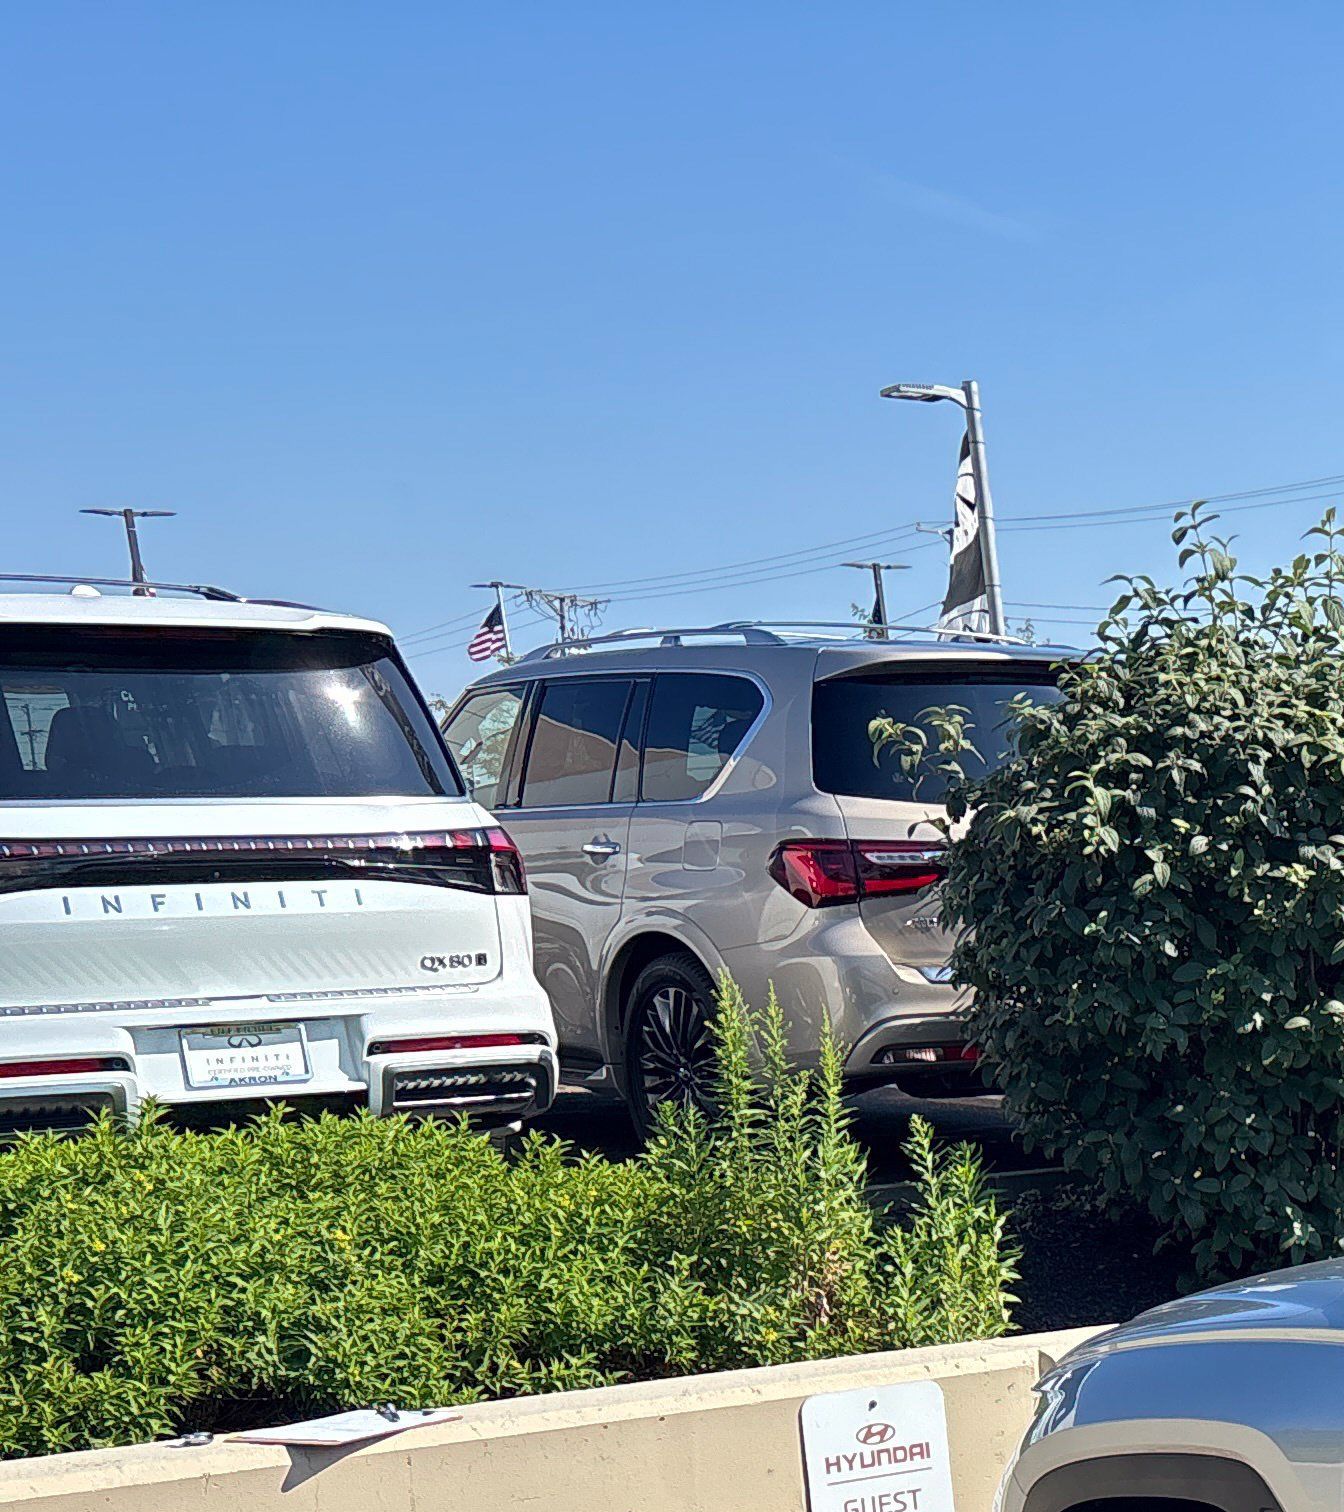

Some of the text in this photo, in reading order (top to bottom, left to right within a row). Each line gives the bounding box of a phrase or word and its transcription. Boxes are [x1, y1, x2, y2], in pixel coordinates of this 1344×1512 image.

[61, 887, 364, 916] INFINITI
[420, 953, 473, 973] QX80
[206, 1053, 291, 1066] INFINITI
[228, 1074, 278, 1086] AKRON
[824, 1441, 931, 1475] HYUNDAI
